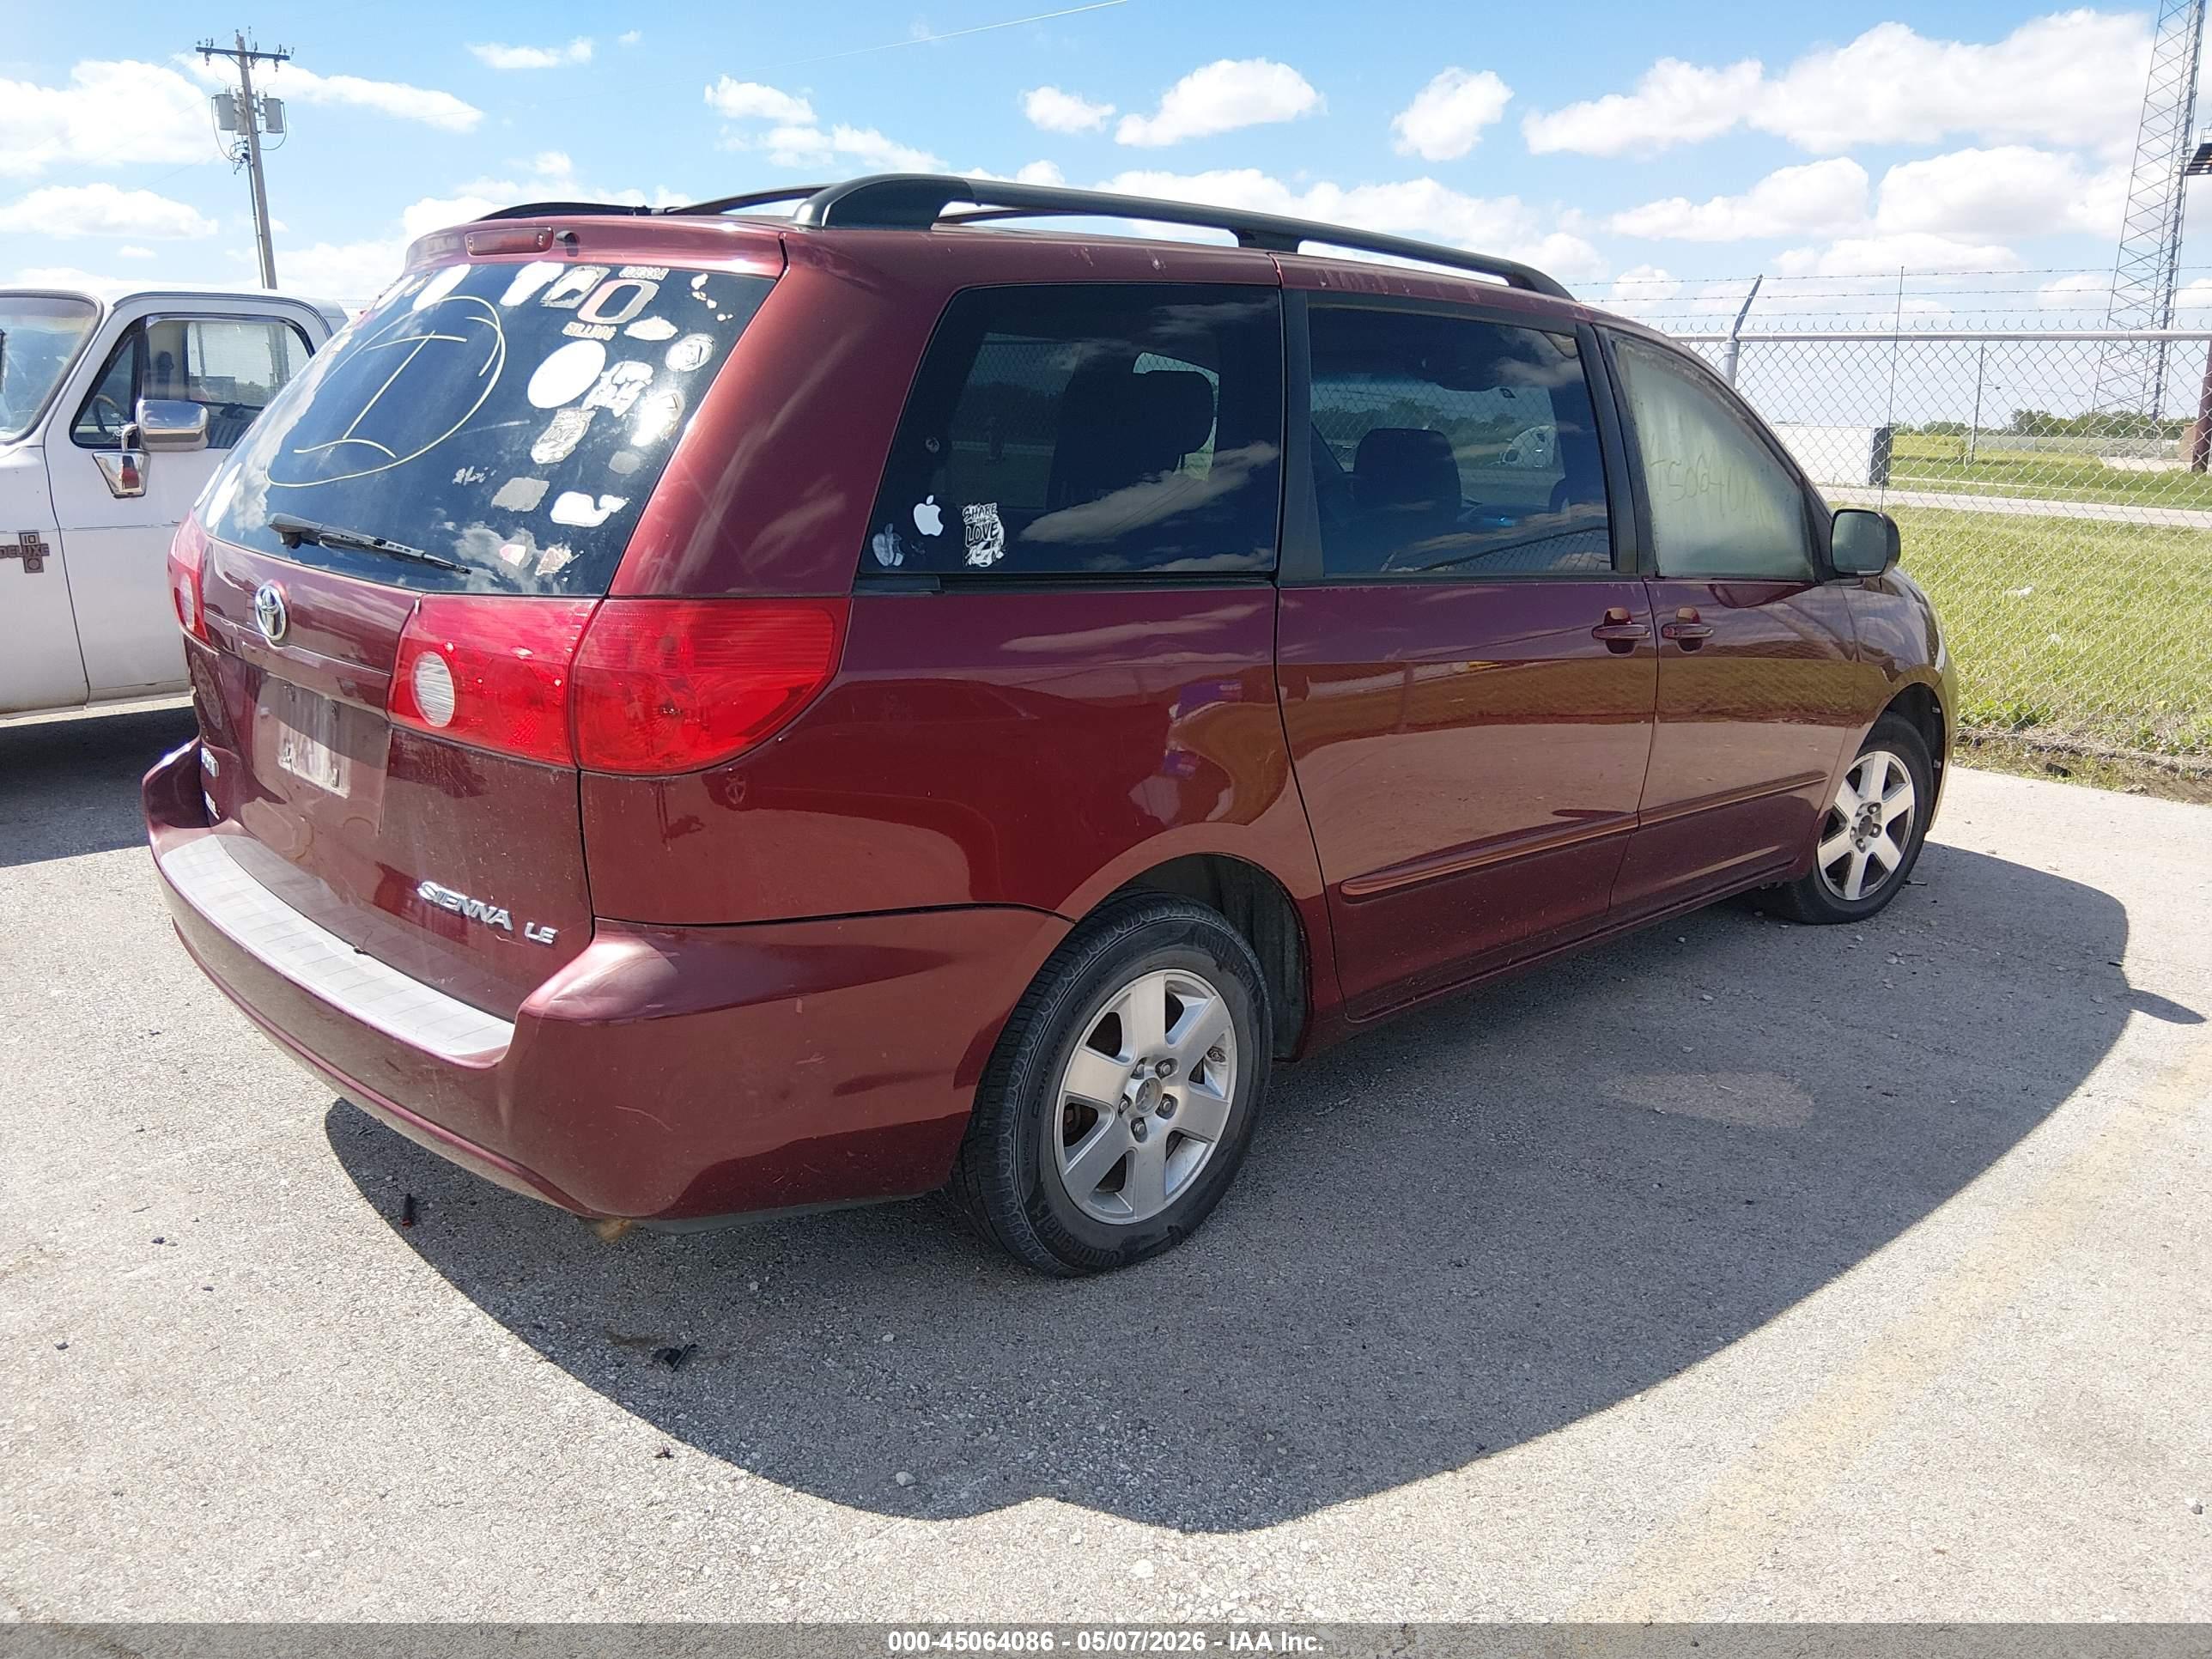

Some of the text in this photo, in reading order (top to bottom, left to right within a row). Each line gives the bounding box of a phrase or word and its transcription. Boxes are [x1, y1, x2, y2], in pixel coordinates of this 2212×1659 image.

[963, 502, 998, 525] SHARE
[23, 534, 37, 544] 10
[964, 520, 1000, 548] LOVE
[416, 880, 514, 932] SIENNA
[524, 921, 559, 945] LE
